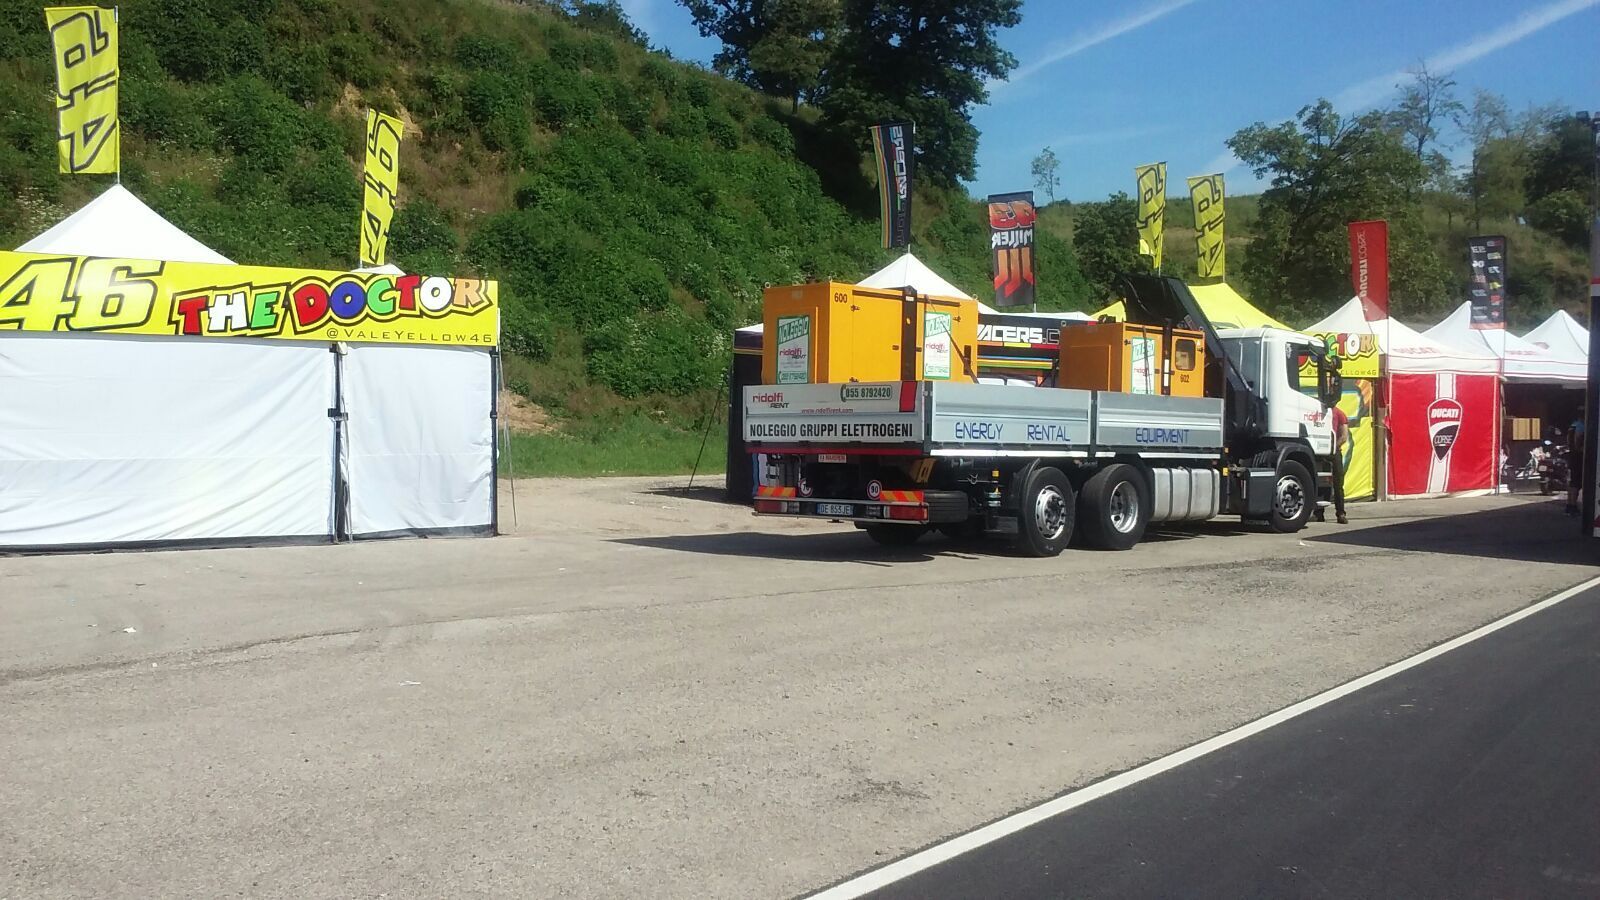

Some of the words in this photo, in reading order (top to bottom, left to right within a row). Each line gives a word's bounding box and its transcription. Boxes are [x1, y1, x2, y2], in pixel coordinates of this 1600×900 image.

[364, 113, 401, 264] 46
[0, 256, 166, 331] 46
[834, 292, 848, 303] 600
[175, 287, 283, 335] THE
[292, 274, 487, 328] DOCTOR
[977, 324, 1060, 345] ACERS.C
[780, 348, 802, 356] ridolfi
[752, 393, 783, 403] ridolfi
[845, 388, 859, 398] 055
[861, 388, 891, 398] 8792420
[1431, 408, 1459, 418] DUCATI
[750, 424, 797, 437] NOLEGGIO
[800, 424, 837, 437] GRUPPI
[842, 423, 913, 437] ELETTROGENI
[955, 422, 1003, 440] ENERGY
[1027, 424, 1071, 441] RENTAL
[1136, 428, 1189, 443] EQUIPMENT
[1435, 435, 1453, 444] CORSE
